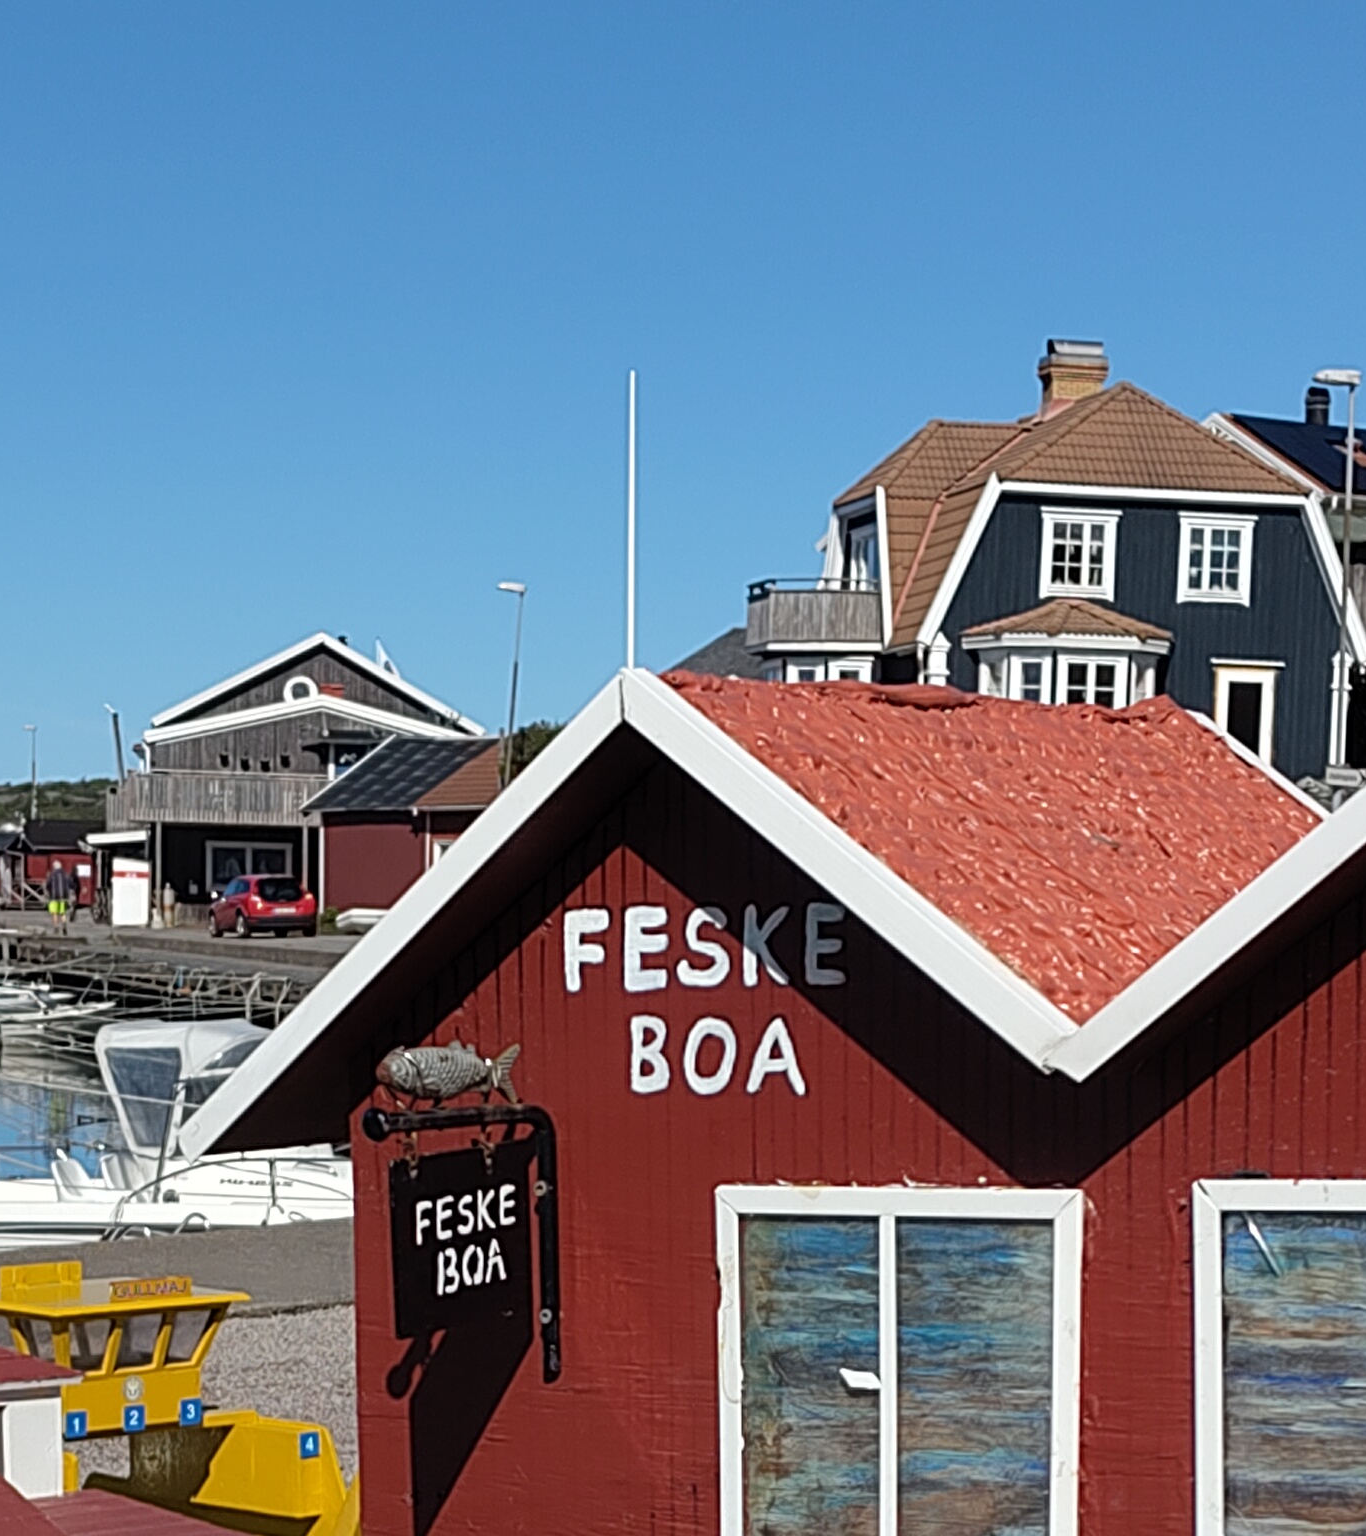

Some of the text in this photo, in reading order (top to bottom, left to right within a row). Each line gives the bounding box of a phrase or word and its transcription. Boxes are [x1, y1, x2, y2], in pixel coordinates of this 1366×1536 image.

[563, 902, 847, 993] FESKE
[630, 1014, 807, 1096] BOA
[415, 1183, 517, 1246] FESKE
[436, 1237, 507, 1296] BOA
[72, 1403, 196, 1434] 1 2 3
[305, 1436, 315, 1452] 4
